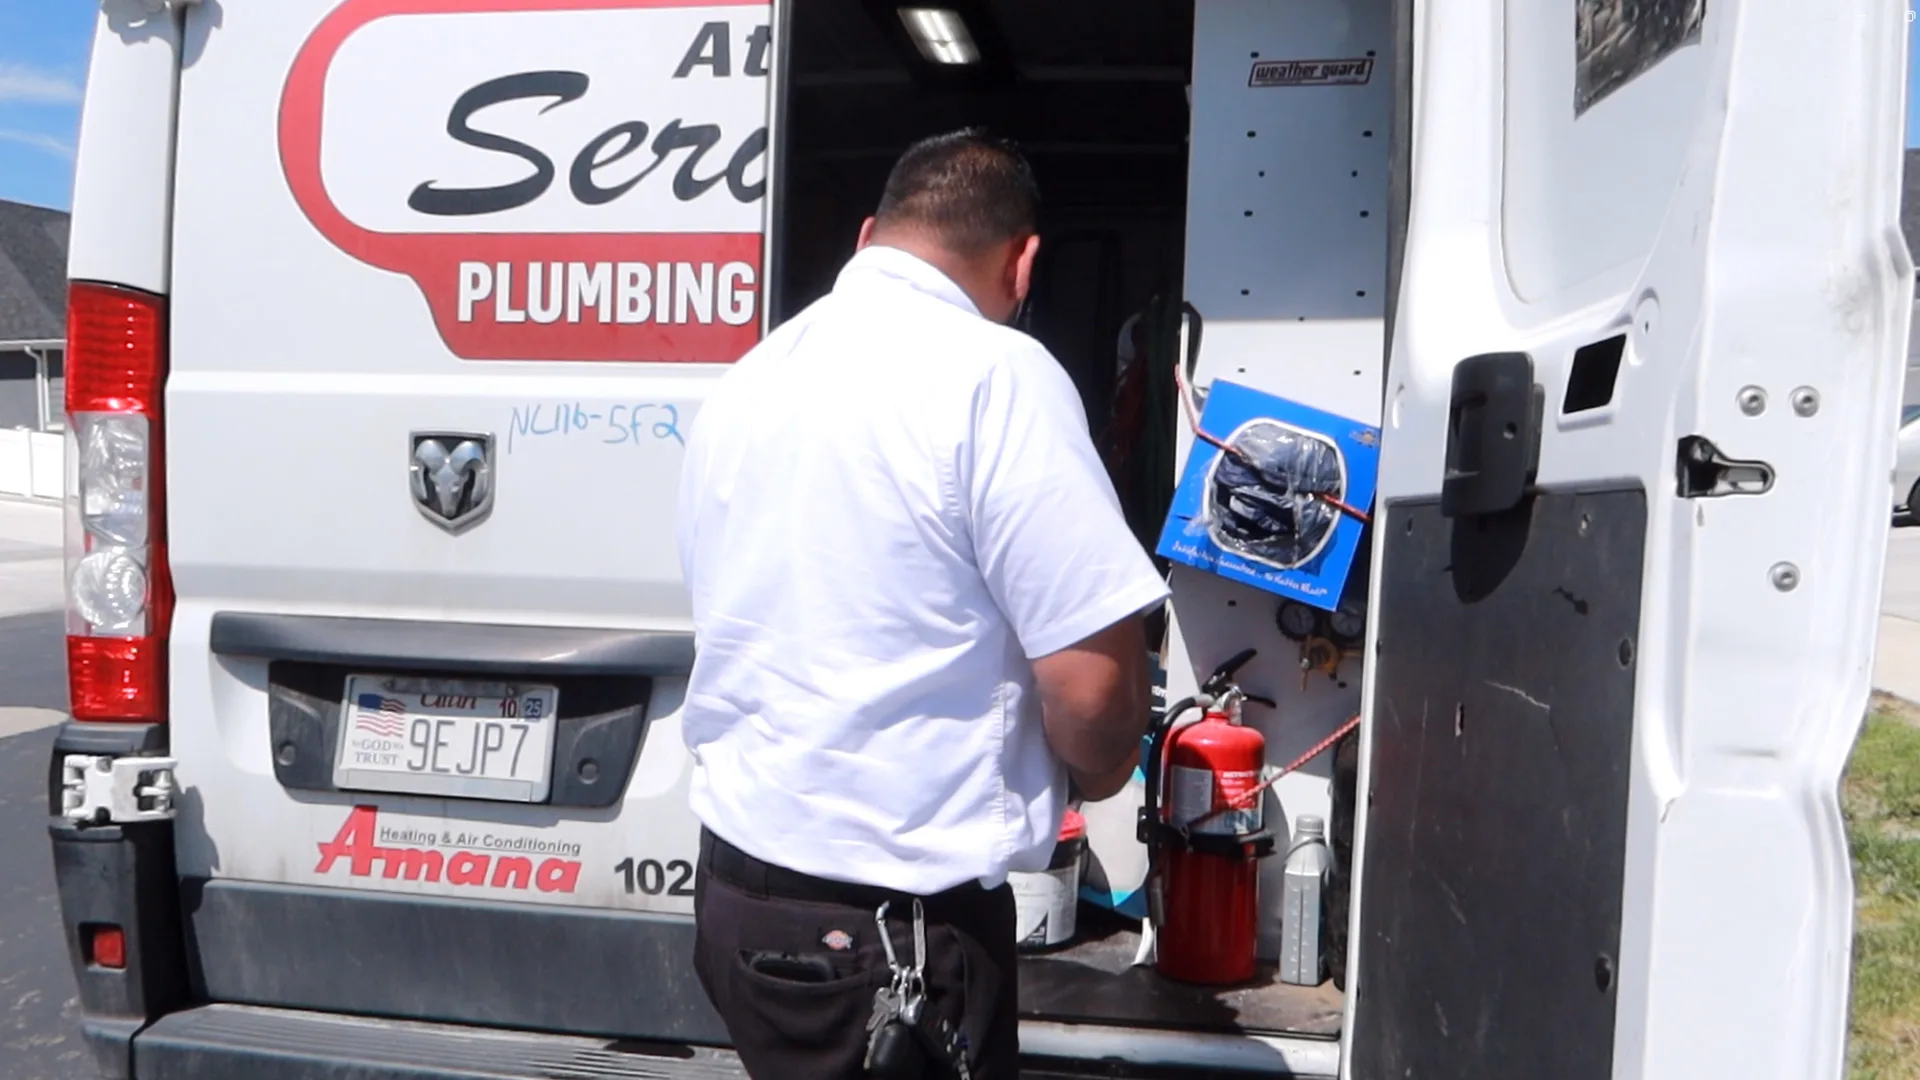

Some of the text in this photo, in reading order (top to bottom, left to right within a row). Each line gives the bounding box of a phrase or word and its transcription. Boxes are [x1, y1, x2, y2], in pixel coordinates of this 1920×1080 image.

[672, 21, 771, 78] At
[1255, 61, 1367, 80] weather guard
[456, 261, 756, 327] PLUMBING
[499, 698, 541, 718] 10 25
[355, 751, 399, 766] TRUST
[360, 738, 392, 751] GOD
[407, 718, 529, 777] 9EJP7
[314, 804, 583, 894] Amana
[380, 827, 582, 855] Heating & Air Conditioning
[614, 857, 695, 896] 102
